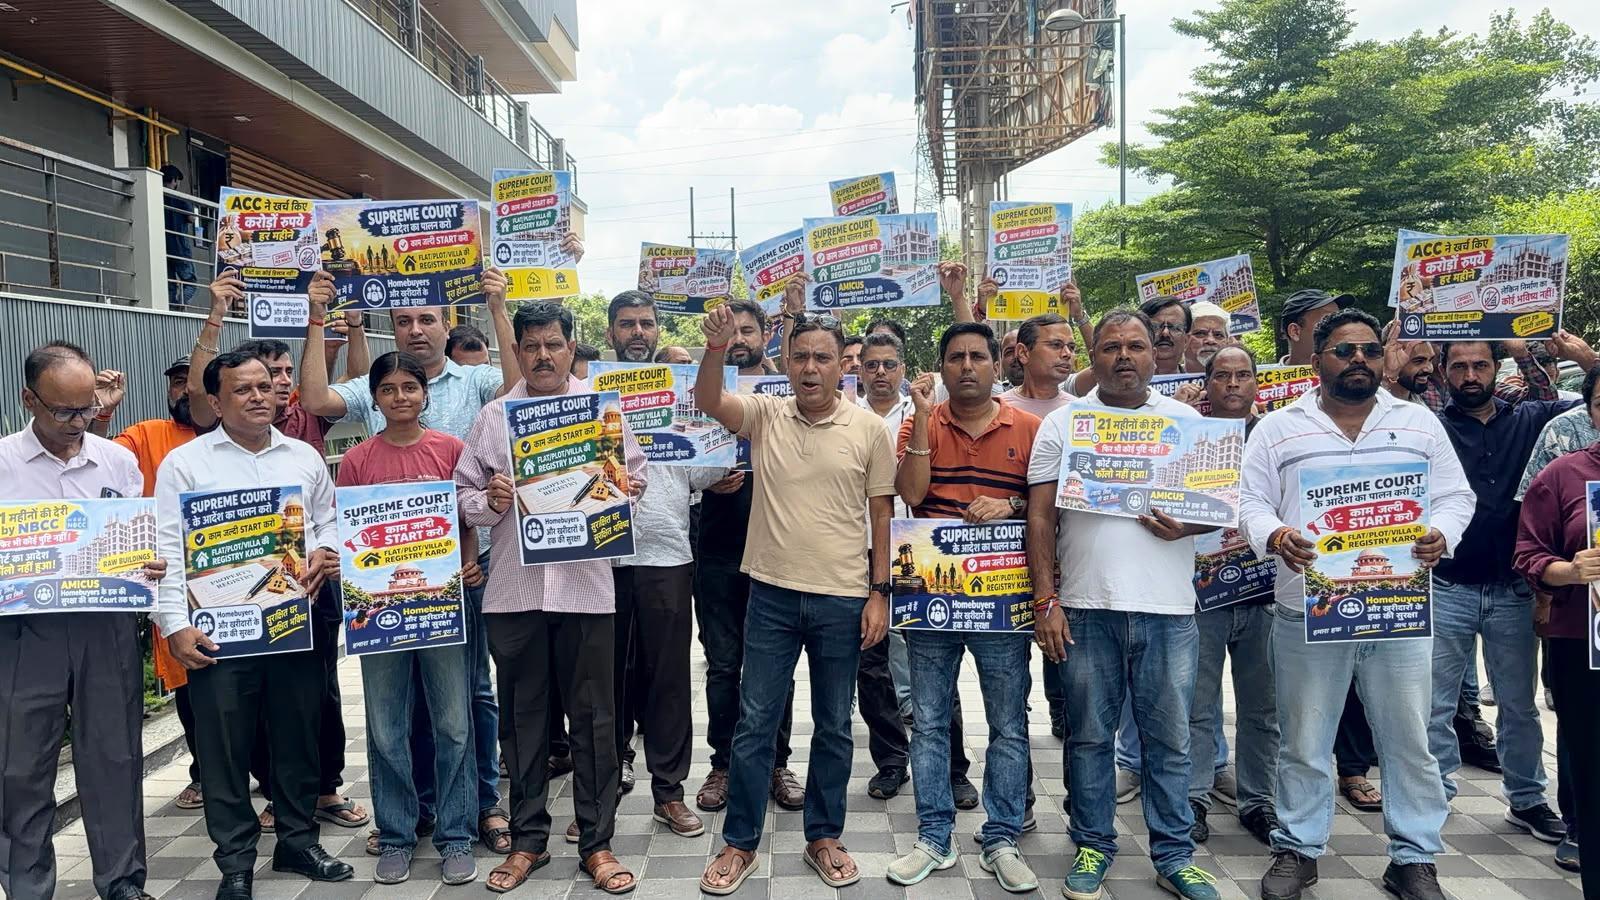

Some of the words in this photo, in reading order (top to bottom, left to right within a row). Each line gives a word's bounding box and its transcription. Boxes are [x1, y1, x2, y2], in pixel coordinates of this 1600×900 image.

[499, 178, 530, 191] SUPREME
[530, 175, 552, 187] COURT
[836, 184, 860, 199] SUPREME
[860, 177, 880, 189] COURT
[231, 197, 262, 211] ACC
[265, 200, 272, 211] ने
[273, 200, 289, 211] खर्च
[291, 200, 308, 211] किए
[996, 208, 1028, 221] SUPREME
[1029, 205, 1053, 217] COURT
[244, 213, 279, 231] करोड़ों
[279, 214, 305, 228] रुपये
[368, 207, 421, 226] SUPREME
[421, 203, 459, 221] COURT
[258, 231, 271, 242] हर
[272, 228, 295, 241] महीने
[812, 224, 848, 240] SUPREME
[848, 218, 874, 233] COURT
[418, 250, 463, 262] FLAT/PLOT/VILLA
[647, 247, 666, 257] ACC
[745, 250, 777, 272] SUPREME
[778, 236, 804, 254] COURT
[1411, 241, 1443, 258] ACC
[1444, 241, 1452, 252] ने
[1453, 240, 1471, 251] खर्च
[1471, 237, 1489, 250] किए
[420, 259, 449, 270] REGISTRY
[449, 257, 466, 268] KARO
[655, 258, 677, 269] करोड़ों
[677, 256, 691, 267] रुपये
[1424, 253, 1459, 274] करोड़ों
[1460, 251, 1486, 270] रुपये
[830, 267, 857, 280] REGISTRY
[857, 264, 873, 276] KARO
[1156, 279, 1165, 290] 21
[1165, 273, 1181, 287] महीनों
[1181, 270, 1189, 281] की
[1189, 268, 1198, 279] देरी
[1439, 274, 1452, 287] हर
[1452, 268, 1476, 284] महीने
[387, 279, 430, 290] Homebuyers
[838, 280, 865, 292] AMICUS
[1144, 285, 1153, 296] 21
[1163, 286, 1171, 295] by
[1171, 279, 1195, 292] NBCC
[1499, 281, 1519, 295] लेकिन
[1519, 279, 1538, 291] निर्माण
[1538, 279, 1548, 290] का
[1501, 293, 1516, 306] कोई
[1516, 290, 1539, 304] भविष्य
[598, 371, 638, 387] SUPREME
[639, 367, 668, 382] COURT
[1255, 371, 1273, 385] CC
[1275, 371, 1281, 381] ने
[1283, 369, 1298, 381] खर्च
[1259, 381, 1288, 400] करोड़ों
[1290, 378, 1313, 395] रुपये
[516, 401, 561, 423] SUPREME
[562, 396, 592, 413] COURT
[1076, 421, 1091, 434] 21
[1097, 417, 1111, 430] 21
[1113, 417, 1137, 432] महीनों
[1139, 418, 1149, 430] की
[1151, 418, 1165, 431] देरी
[533, 438, 546, 449] काम
[547, 433, 562, 446] जल्दी
[562, 430, 584, 442] START
[584, 425, 597, 438] करो
[1105, 431, 1117, 443] by
[1119, 429, 1155, 442] NBCC
[537, 446, 583, 464] FLAT/PLOT/VILLA
[583, 443, 592, 454] की
[539, 458, 568, 473] REGISTRY
[569, 453, 587, 466] KARO
[1095, 457, 1110, 470] कोर्ट
[1111, 459, 1122, 470] का
[1123, 457, 1143, 471] आदेश
[1094, 468, 1114, 481] फॉलो
[1115, 468, 1130, 480] नहीं
[1150, 490, 1186, 501] AMICUS
[1306, 480, 1371, 501] SUPREME
[1374, 473, 1424, 490] COURT
[190, 493, 239, 514] SUPREME
[240, 489, 273, 505] COURT
[343, 499, 404, 520] SUPREME
[406, 491, 451, 509] COURT
[1313, 498, 1324, 509] के
[1325, 494, 1354, 509] आदेश
[1354, 493, 1368, 504] का
[1369, 489, 1393, 502] पालन
[1394, 486, 1410, 498] करो
[8, 508, 38, 525] महीनों
[39, 505, 52, 519] की
[53, 503, 69, 519] देरी
[191, 515, 201, 528] के
[225, 509, 237, 523] का
[237, 507, 257, 522] पालन
[257, 502, 273, 517] करो
[350, 515, 360, 528] के
[361, 511, 389, 527] आदेश
[389, 511, 402, 522] का
[402, 507, 424, 519] पालन
[425, 502, 440, 515] करो
[1350, 506, 1377, 518] काम
[1377, 500, 1404, 515] जल्दी
[1, 525, 15, 537] by
[18, 518, 60, 535] NBCC
[384, 523, 410, 534] काम
[410, 515, 435, 531] जल्दी
[1348, 514, 1391, 530] START
[1394, 509, 1415, 523] करो
[384, 530, 424, 546] START
[426, 526, 445, 539] करो
[940, 526, 992, 544] SUPREME
[993, 524, 1027, 541] COURT
[1347, 527, 1412, 542] FLAT/PLOT/VILLA
[1412, 524, 1423, 535] की
[1348, 538, 1390, 550] REGISTRY
[1391, 533, 1417, 545] KARO
[211, 539, 260, 558] FLAT/PLOT/VILLA
[211, 551, 245, 566] REGISTRY
[245, 546, 265, 561] KARO
[384, 542, 444, 557] FLAT/PLOT/VILLA
[443, 537, 453, 549] की
[385, 551, 423, 564] REGISTRY
[424, 546, 449, 559] KARO
[103, 556, 119, 568] RAW
[119, 551, 151, 566] BUILDINGS
[979, 559, 991, 568] काम
[990, 555, 1005, 568] जल्दी
[1004, 555, 1027, 567] START
[60, 588, 102, 598] Homebuyers
[61, 579, 101, 590] AMICUS
[986, 582, 1016, 592] REGISTRY
[952, 599, 996, 611] Homebuyers
[1365, 594, 1427, 606] Homebuyers
[217, 608, 255, 620] Homebuyers
[403, 603, 461, 616] Homebuyers
